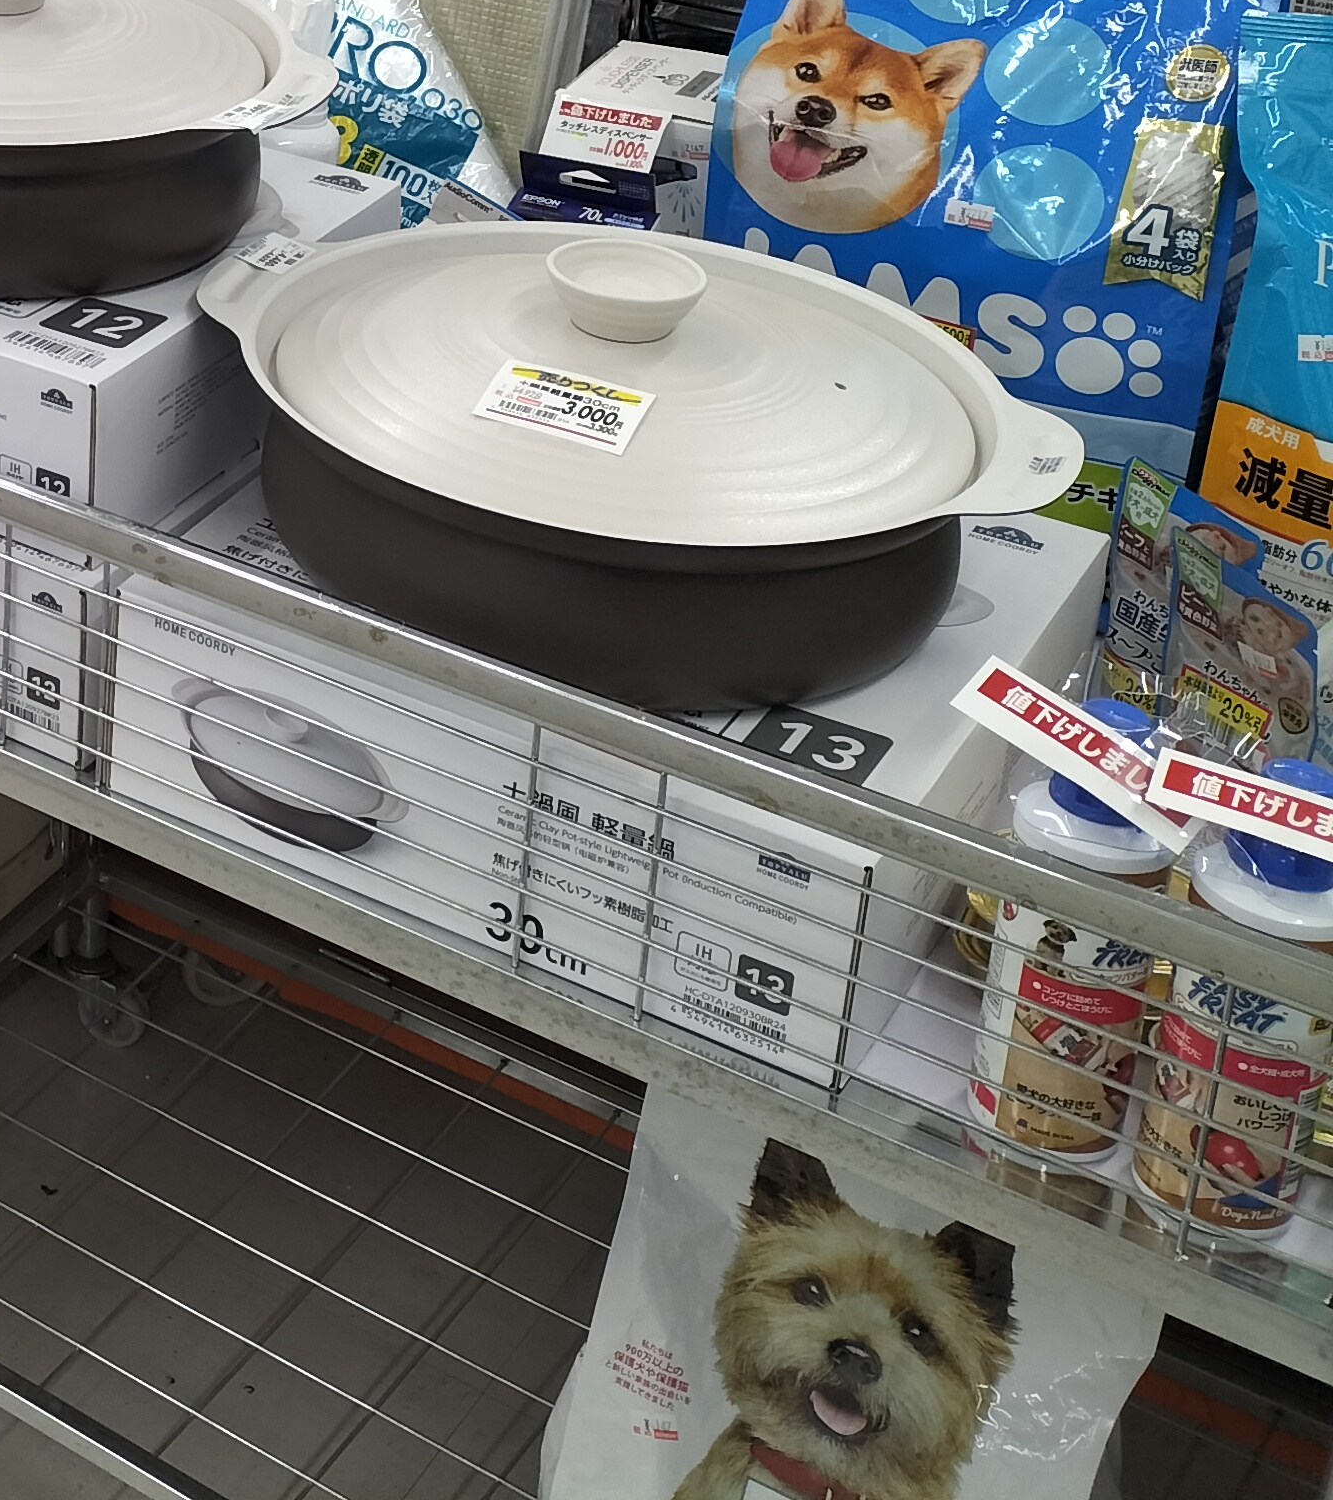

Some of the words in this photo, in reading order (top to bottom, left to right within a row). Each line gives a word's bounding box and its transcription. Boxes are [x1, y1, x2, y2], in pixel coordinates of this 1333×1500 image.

[334, 81, 410, 128] ポリ袋
[382, 159, 427, 200] 100
[522, 193, 563, 209] EPSON
[1126, 209, 1171, 257] 4
[1174, 228, 1201, 251] 袋
[1122, 254, 1195, 275] 小分けパック
[71, 307, 145, 340] 12
[562, 401, 624, 430] 3,000円
[1244, 416, 1300, 450] 成犬用
[1233, 447, 1333, 531] 減量
[776, 720, 868, 773] 13
[562, 826, 602, 848] Pot-style
[744, 967, 786, 1005] 13
[625, 1343, 685, 1377] 900万以上の
